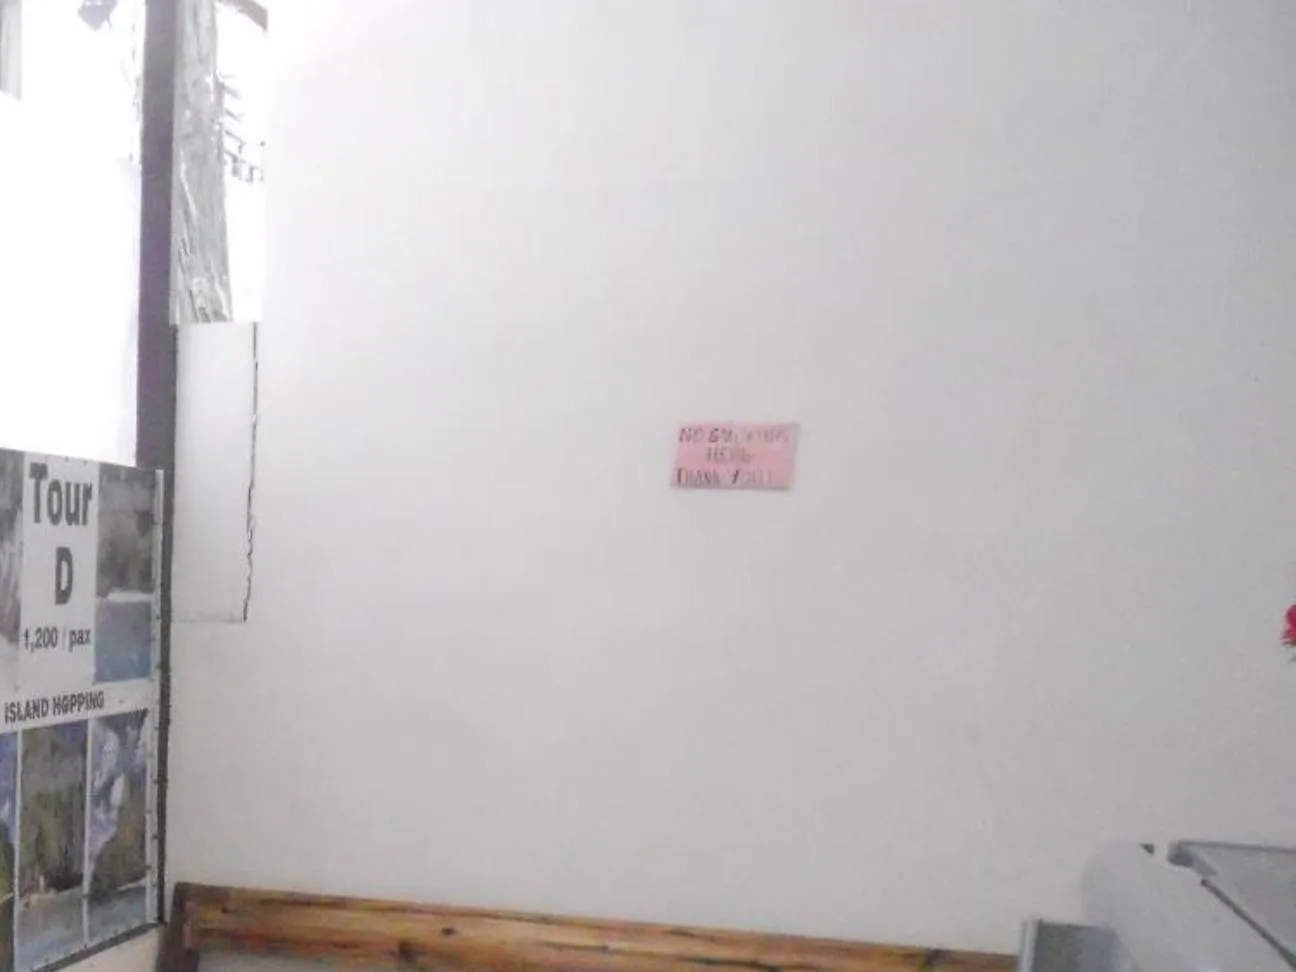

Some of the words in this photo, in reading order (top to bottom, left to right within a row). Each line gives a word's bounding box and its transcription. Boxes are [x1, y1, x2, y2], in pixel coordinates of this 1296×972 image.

[29, 462, 92, 526] Tour
[55, 546, 73, 605] D
[23, 627, 58, 653] 1,200
[68, 628, 91, 651] pax
[4, 698, 49, 724] ISLAND
[53, 691, 105, 715] HOPPING
